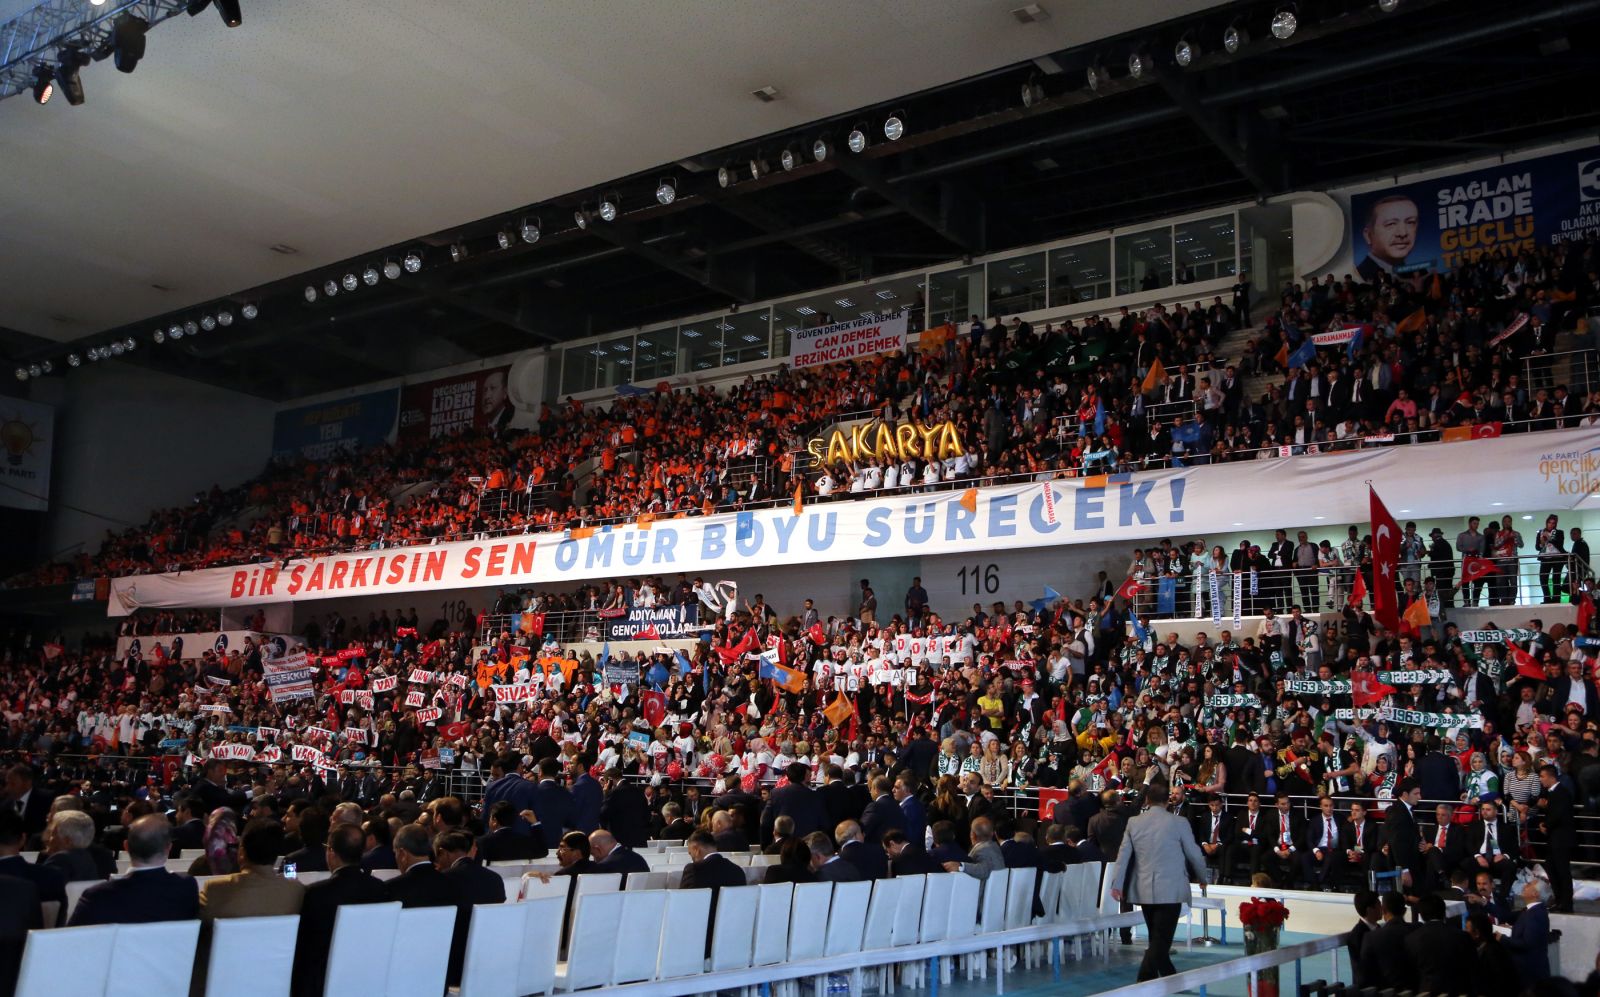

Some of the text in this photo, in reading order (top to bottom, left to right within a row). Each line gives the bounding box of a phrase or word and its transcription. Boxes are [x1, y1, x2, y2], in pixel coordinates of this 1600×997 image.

[1437, 172, 1531, 206] SAĞLAM
[824, 322, 850, 334] DEMEK
[853, 317, 872, 328] VEFA
[874, 313, 902, 324] DEMEK
[815, 326, 881, 349] CAN DEMEK
[858, 335, 900, 355] DEMEK
[808, 421, 965, 470] SAKARYA
[287, 550, 448, 595] ŞARKISIN
[460, 541, 537, 579] SEN
[700, 511, 838, 561] BOYU
[862, 477, 1186, 547] SÜRECEK!
[957, 564, 1000, 595] 116
[441, 600, 466, 623] 118
[629, 608, 677, 622] ADIYAMAN
[1474, 631, 1500, 642] 1963
[414, 671, 430, 683] VAN
[1289, 680, 1316, 693] 1963
[417, 708, 439, 722] VAN
[1393, 708, 1421, 724] 1963
[233, 747, 250, 758] VAN
